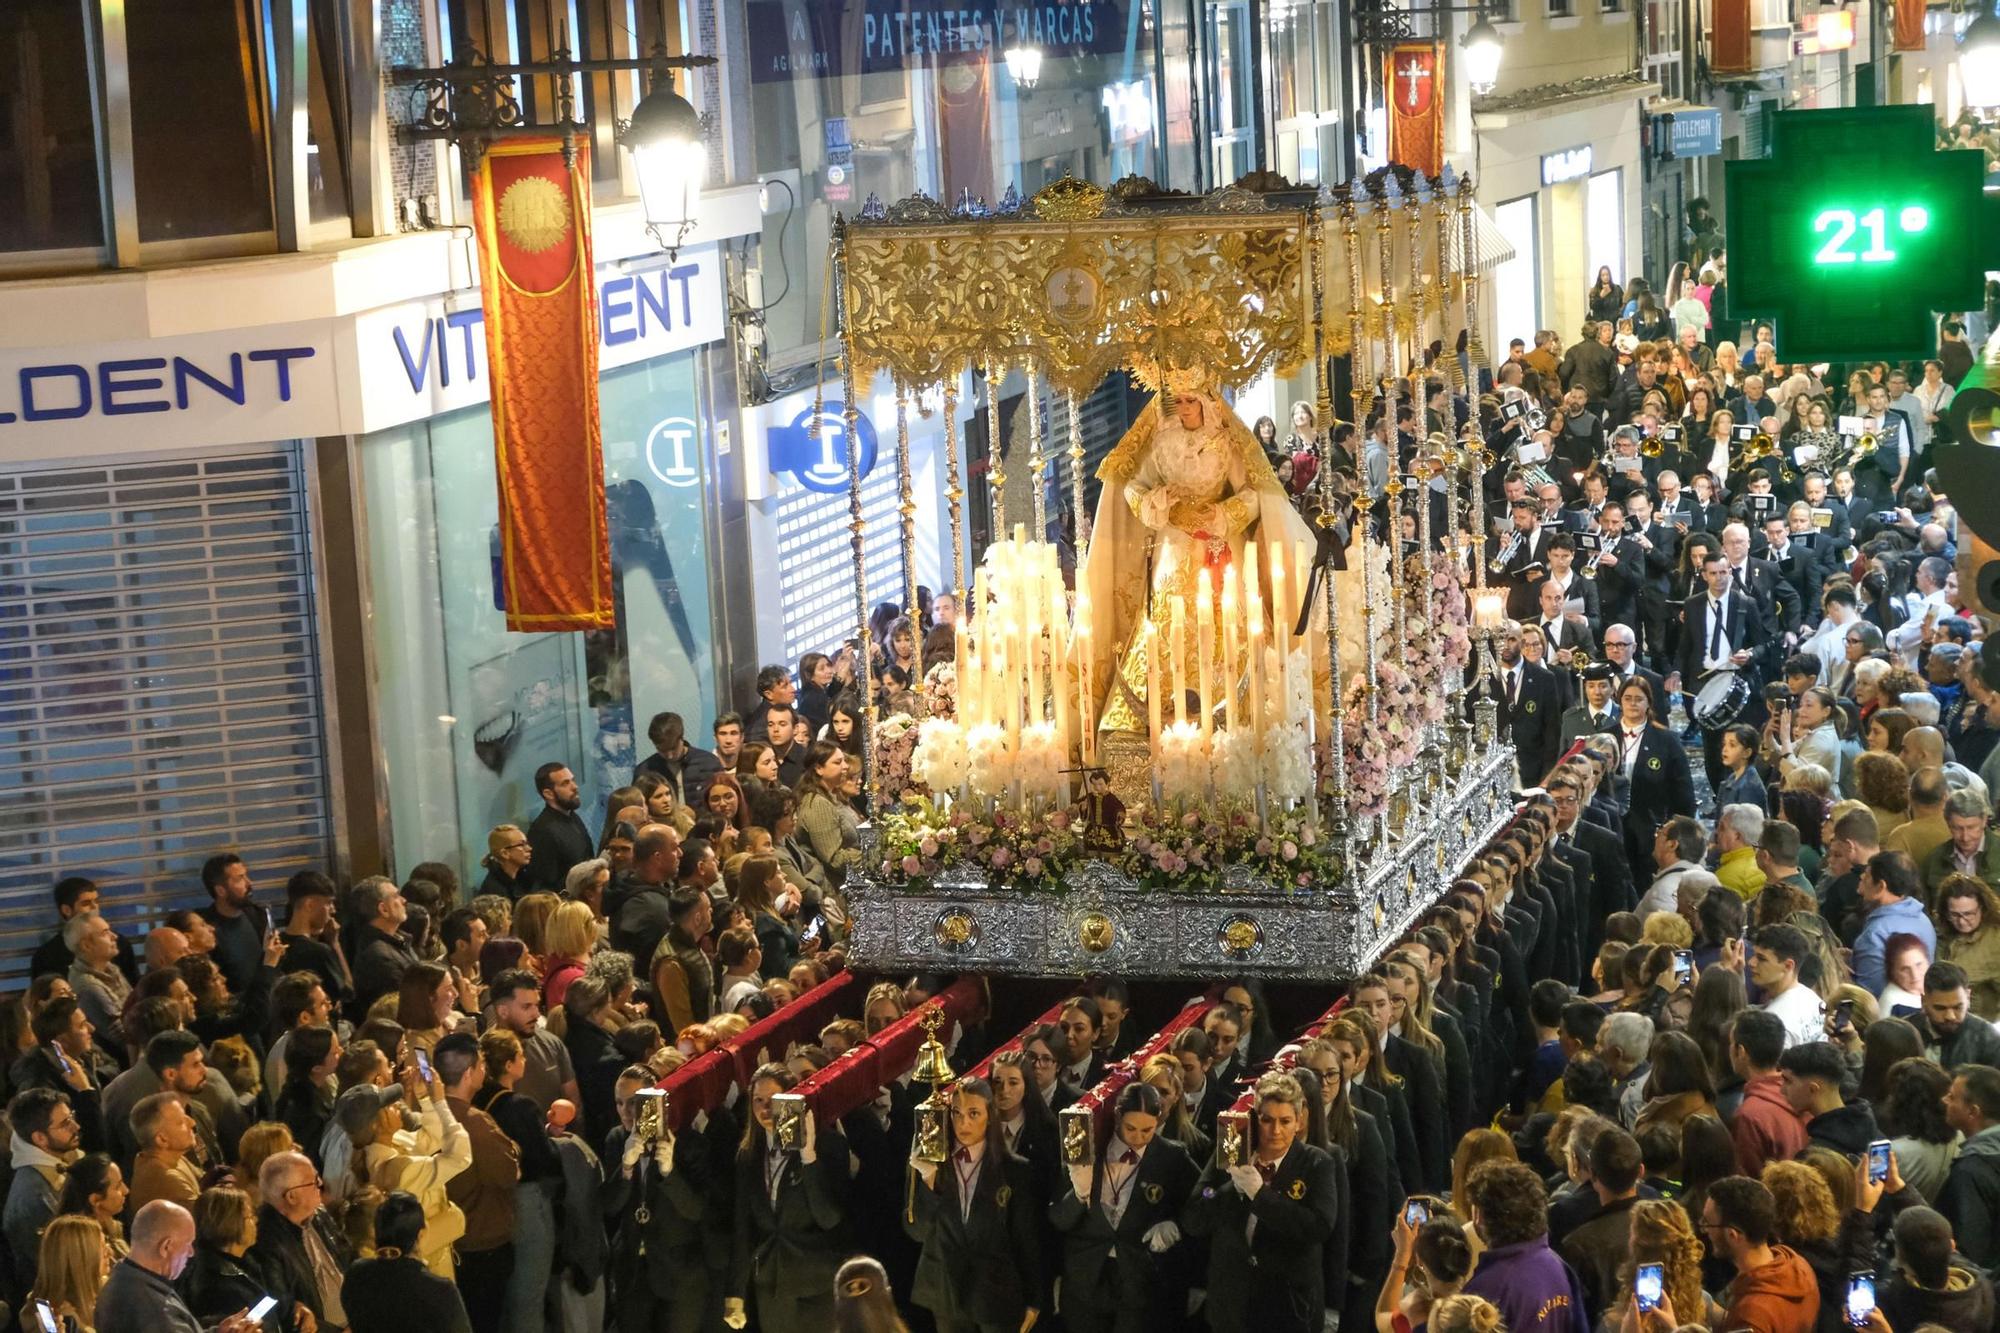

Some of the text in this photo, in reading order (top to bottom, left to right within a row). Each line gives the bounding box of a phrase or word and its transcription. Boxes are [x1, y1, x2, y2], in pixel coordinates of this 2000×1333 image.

[864, 5, 1094, 58] PATENTES Y MARCAS
[773, 51, 829, 72] AGILMARK
[1814, 206, 1928, 264] 21°
[0, 347, 315, 423] DENT
